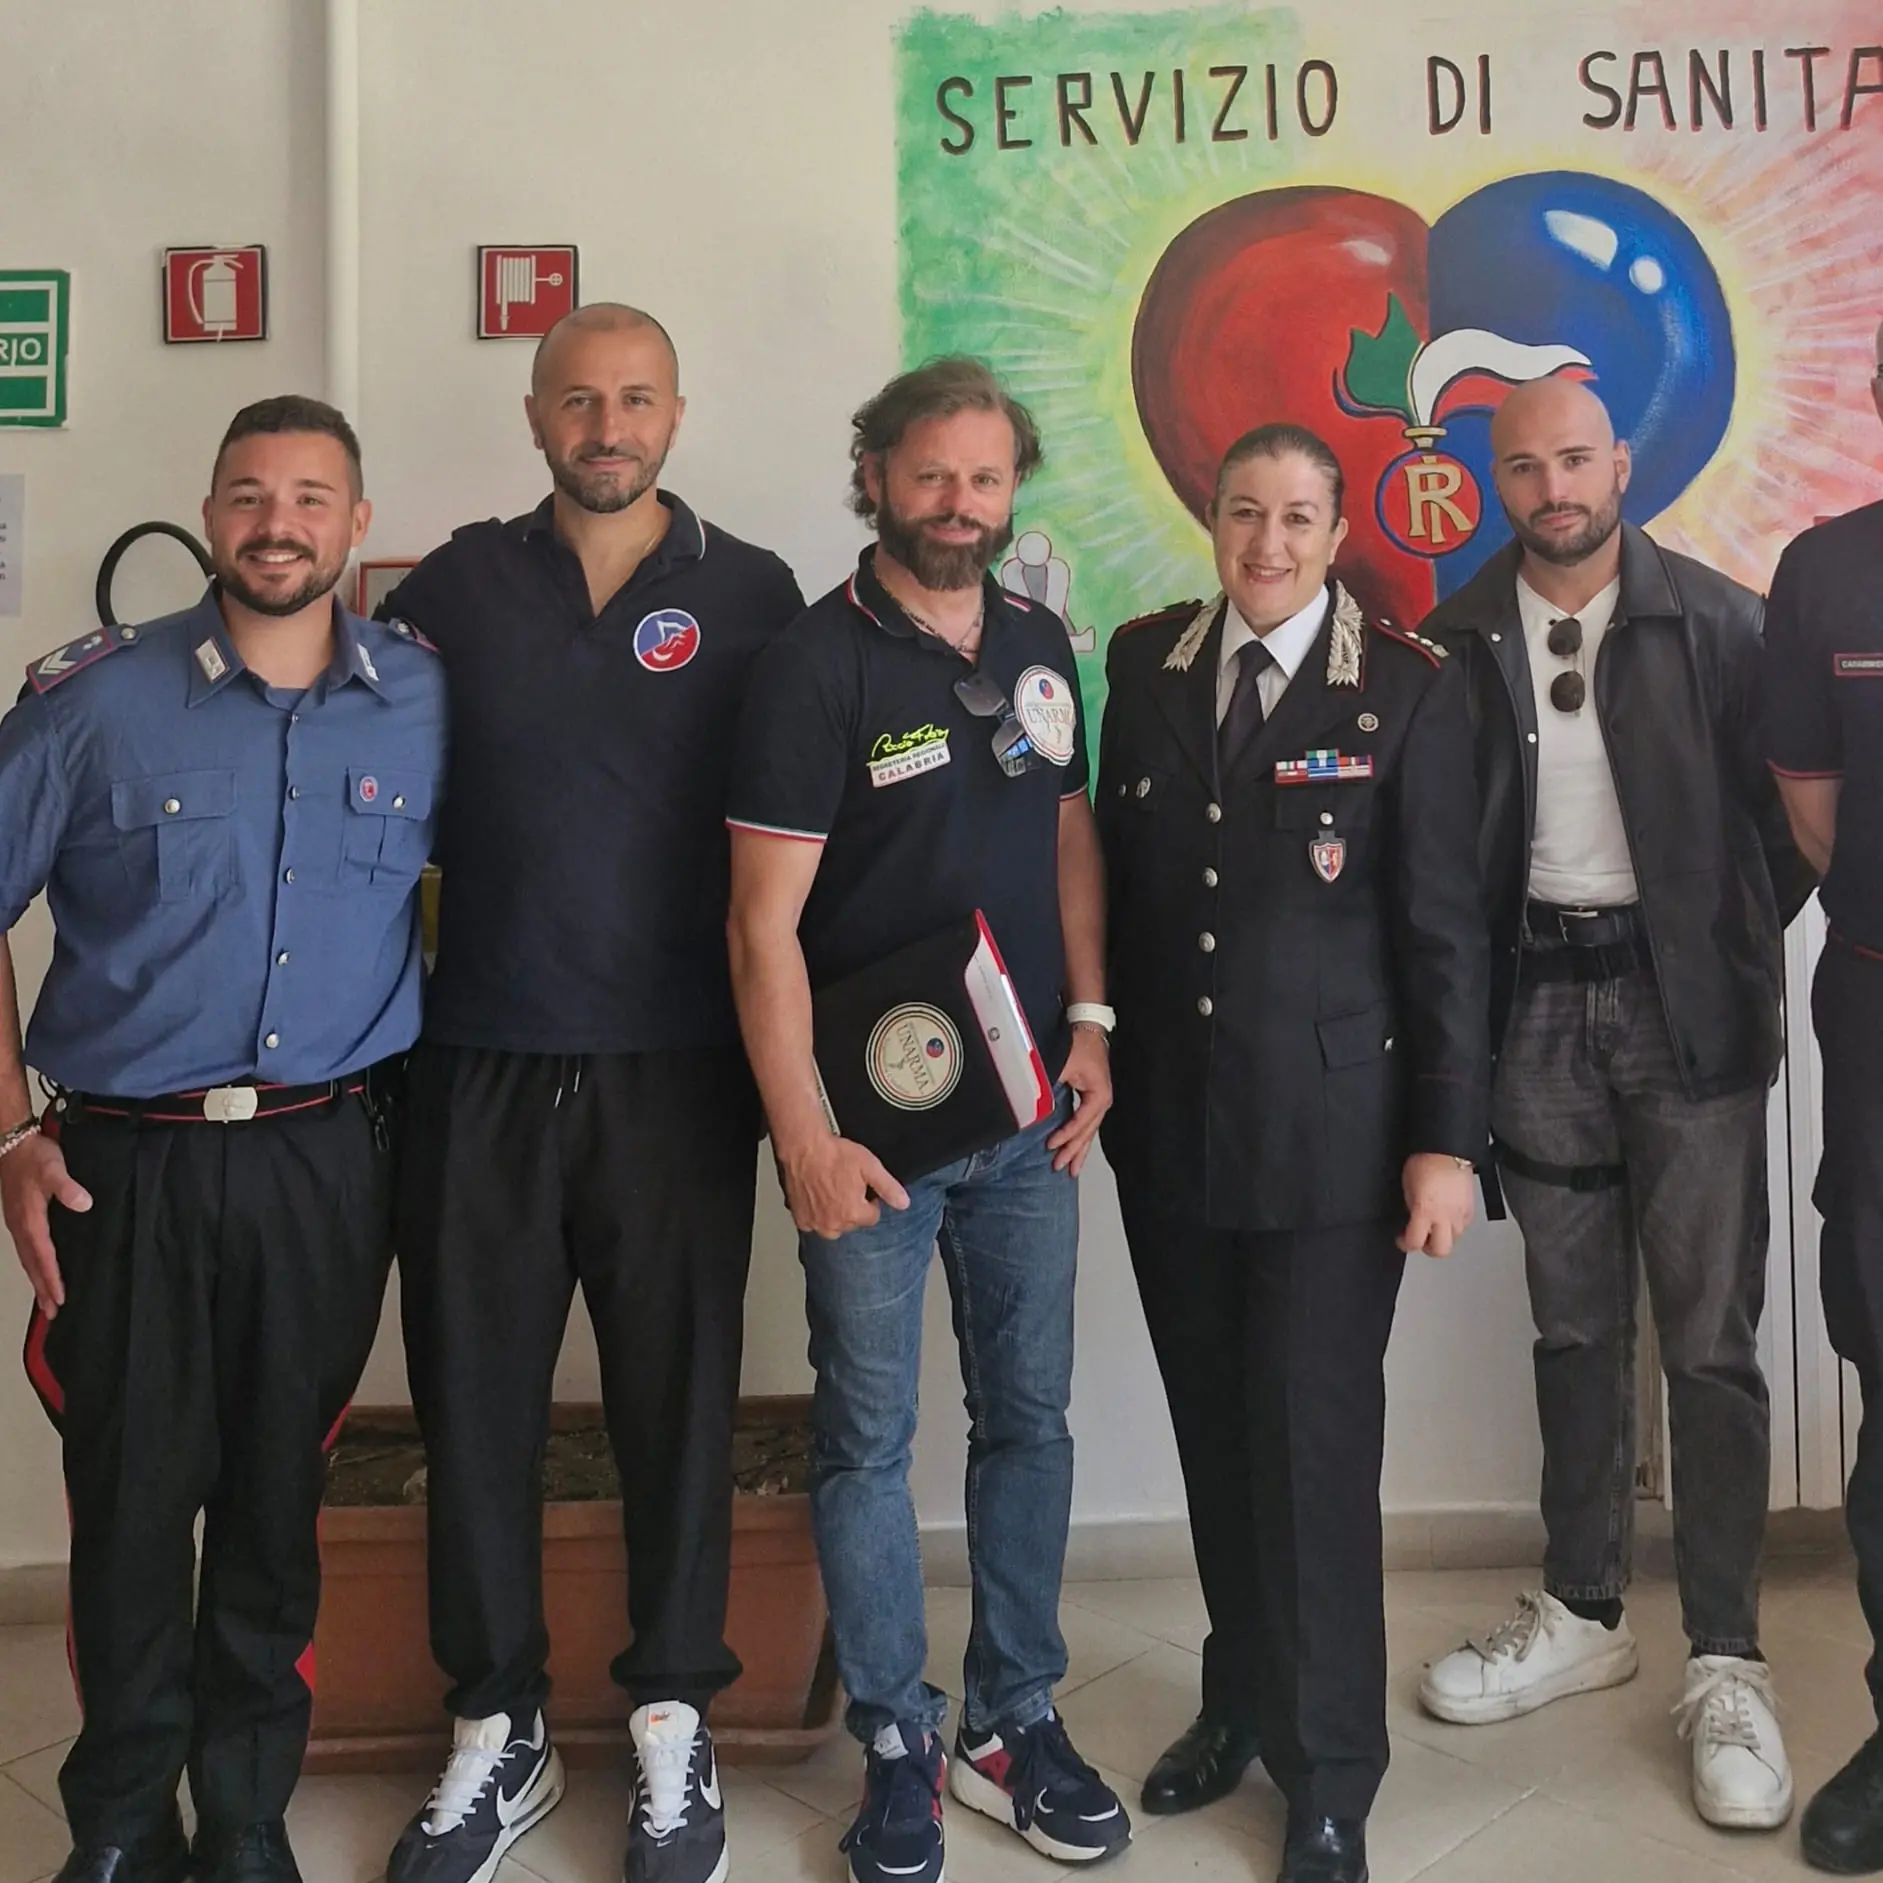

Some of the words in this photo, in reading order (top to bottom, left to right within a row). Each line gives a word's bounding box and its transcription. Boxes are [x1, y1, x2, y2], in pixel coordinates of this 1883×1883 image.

[935, 58, 1339, 155] SERVIZIO
[1426, 53, 1492, 135] DI
[1576, 46, 1883, 133] SANITA
[878, 752, 945, 781] CALABRIA
[896, 1022, 930, 1093] UNARMA
